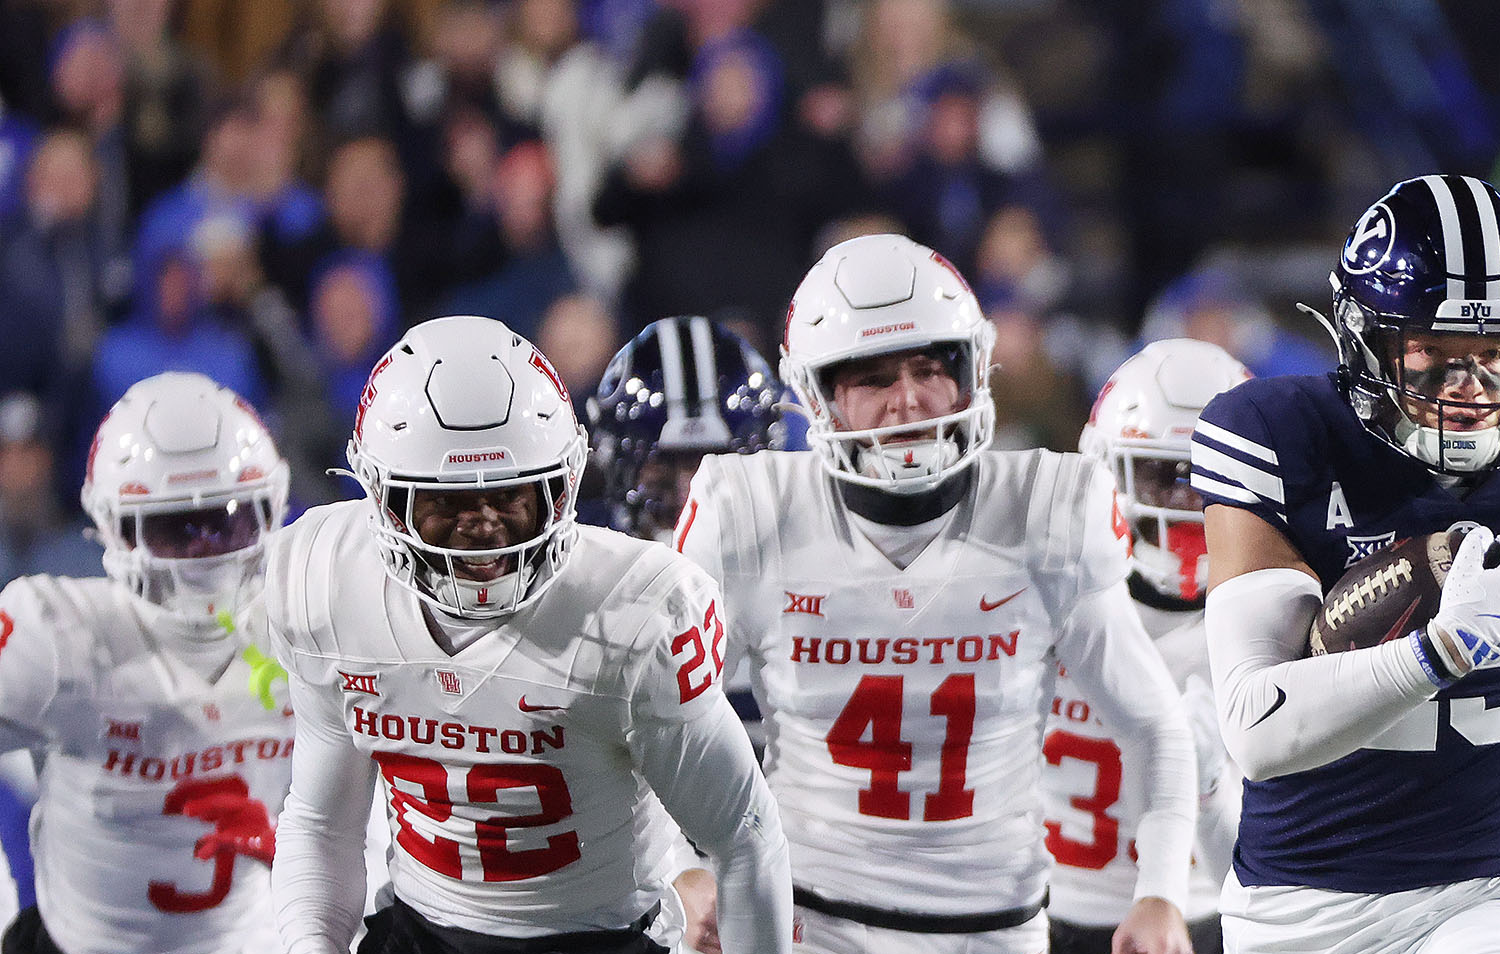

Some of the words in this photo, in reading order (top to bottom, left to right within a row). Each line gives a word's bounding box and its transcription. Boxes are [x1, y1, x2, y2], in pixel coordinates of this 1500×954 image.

[861, 321, 915, 338] HOUSTON
[1461, 302, 1491, 320] BYU
[448, 451, 505, 464] HOUSTON
[1326, 481, 1354, 530] A
[784, 591, 825, 617] XII
[671, 598, 724, 704] 22
[790, 629, 1021, 665] HOUSTON
[337, 670, 381, 697] XII
[353, 706, 566, 755] HOUSTON
[824, 672, 976, 822] 41
[370, 750, 582, 882] 22
[147, 770, 250, 913] 3
